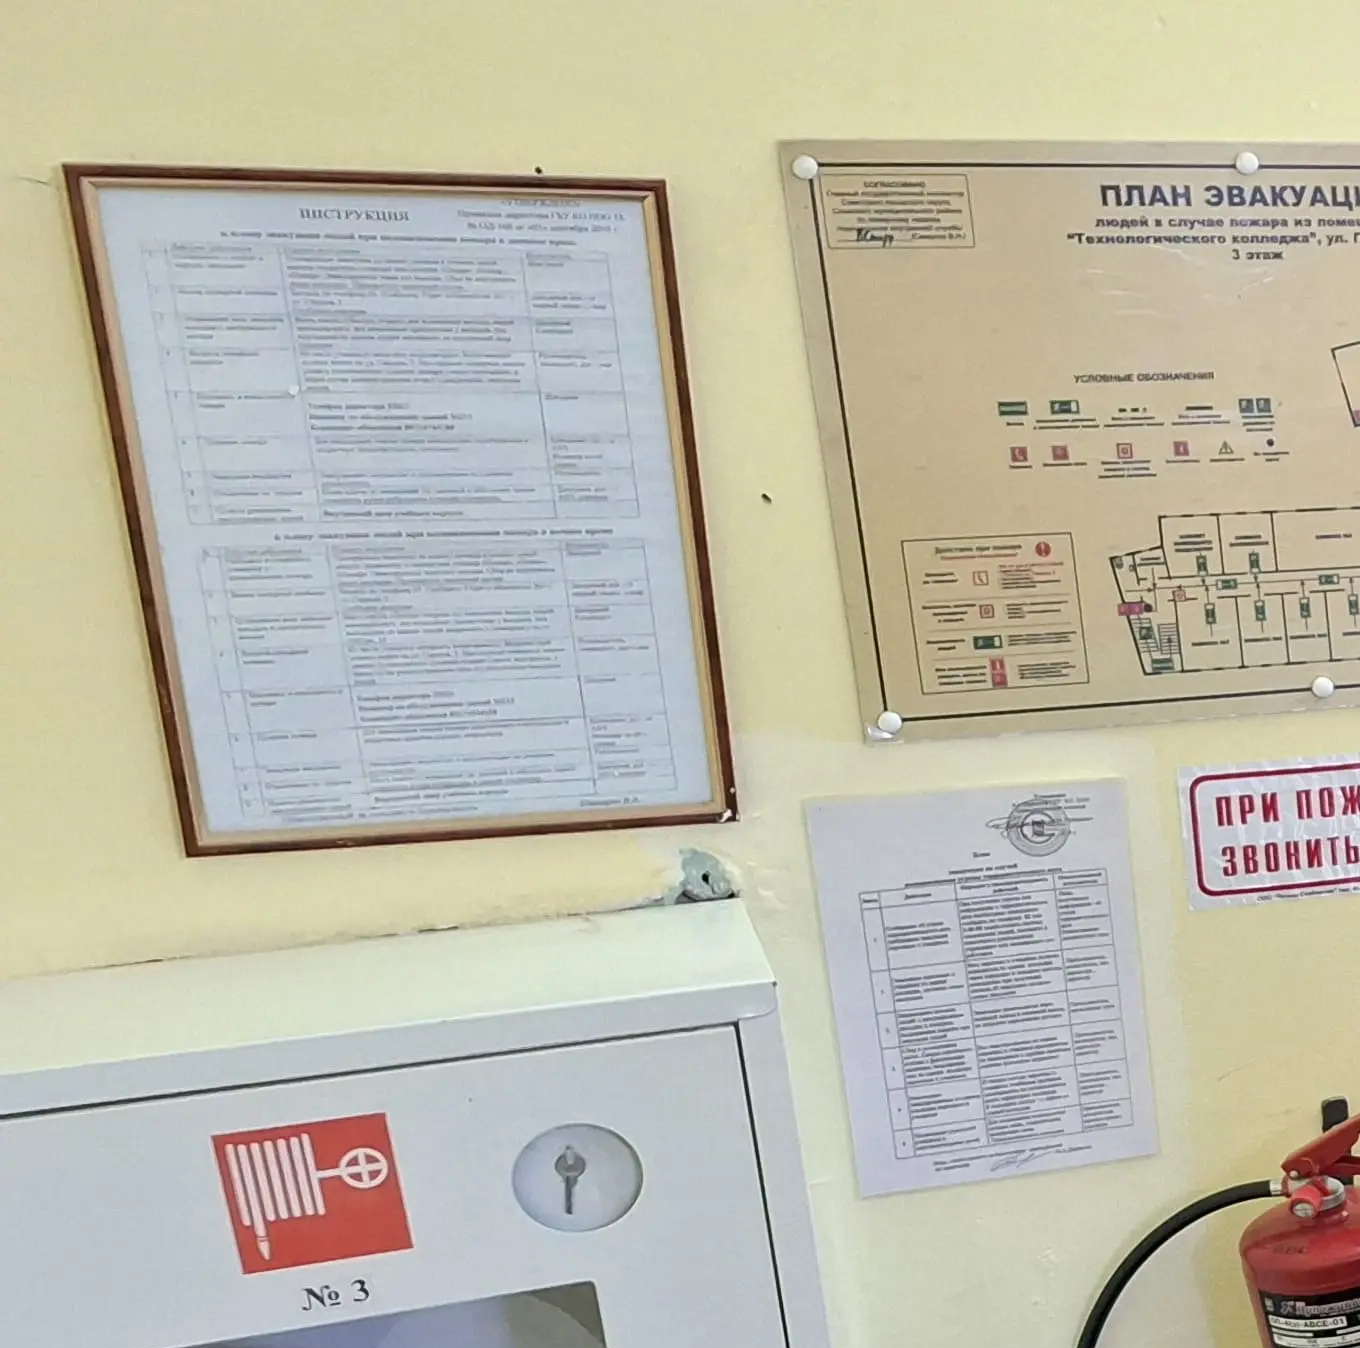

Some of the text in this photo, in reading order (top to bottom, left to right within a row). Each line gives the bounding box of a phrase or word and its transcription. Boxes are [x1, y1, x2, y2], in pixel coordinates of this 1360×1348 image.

[1100, 184, 1193, 207] ПЛАН
[299, 207, 409, 222] ИНСТРУКЦИЯ
[1094, 217, 1149, 229] людей
[1154, 218, 1163, 228] в
[1167, 217, 1224, 230] случае
[1229, 217, 1289, 229] пожара
[1294, 218, 1312, 228] из
[1326, 233, 1349, 247] ул.
[1231, 249, 1284, 261] 3 этаж
[1215, 792, 1280, 827] ПРИ
[1221, 835, 1360, 877] ЗВОНИТЬ
[302, 1279, 369, 1311] № 3
